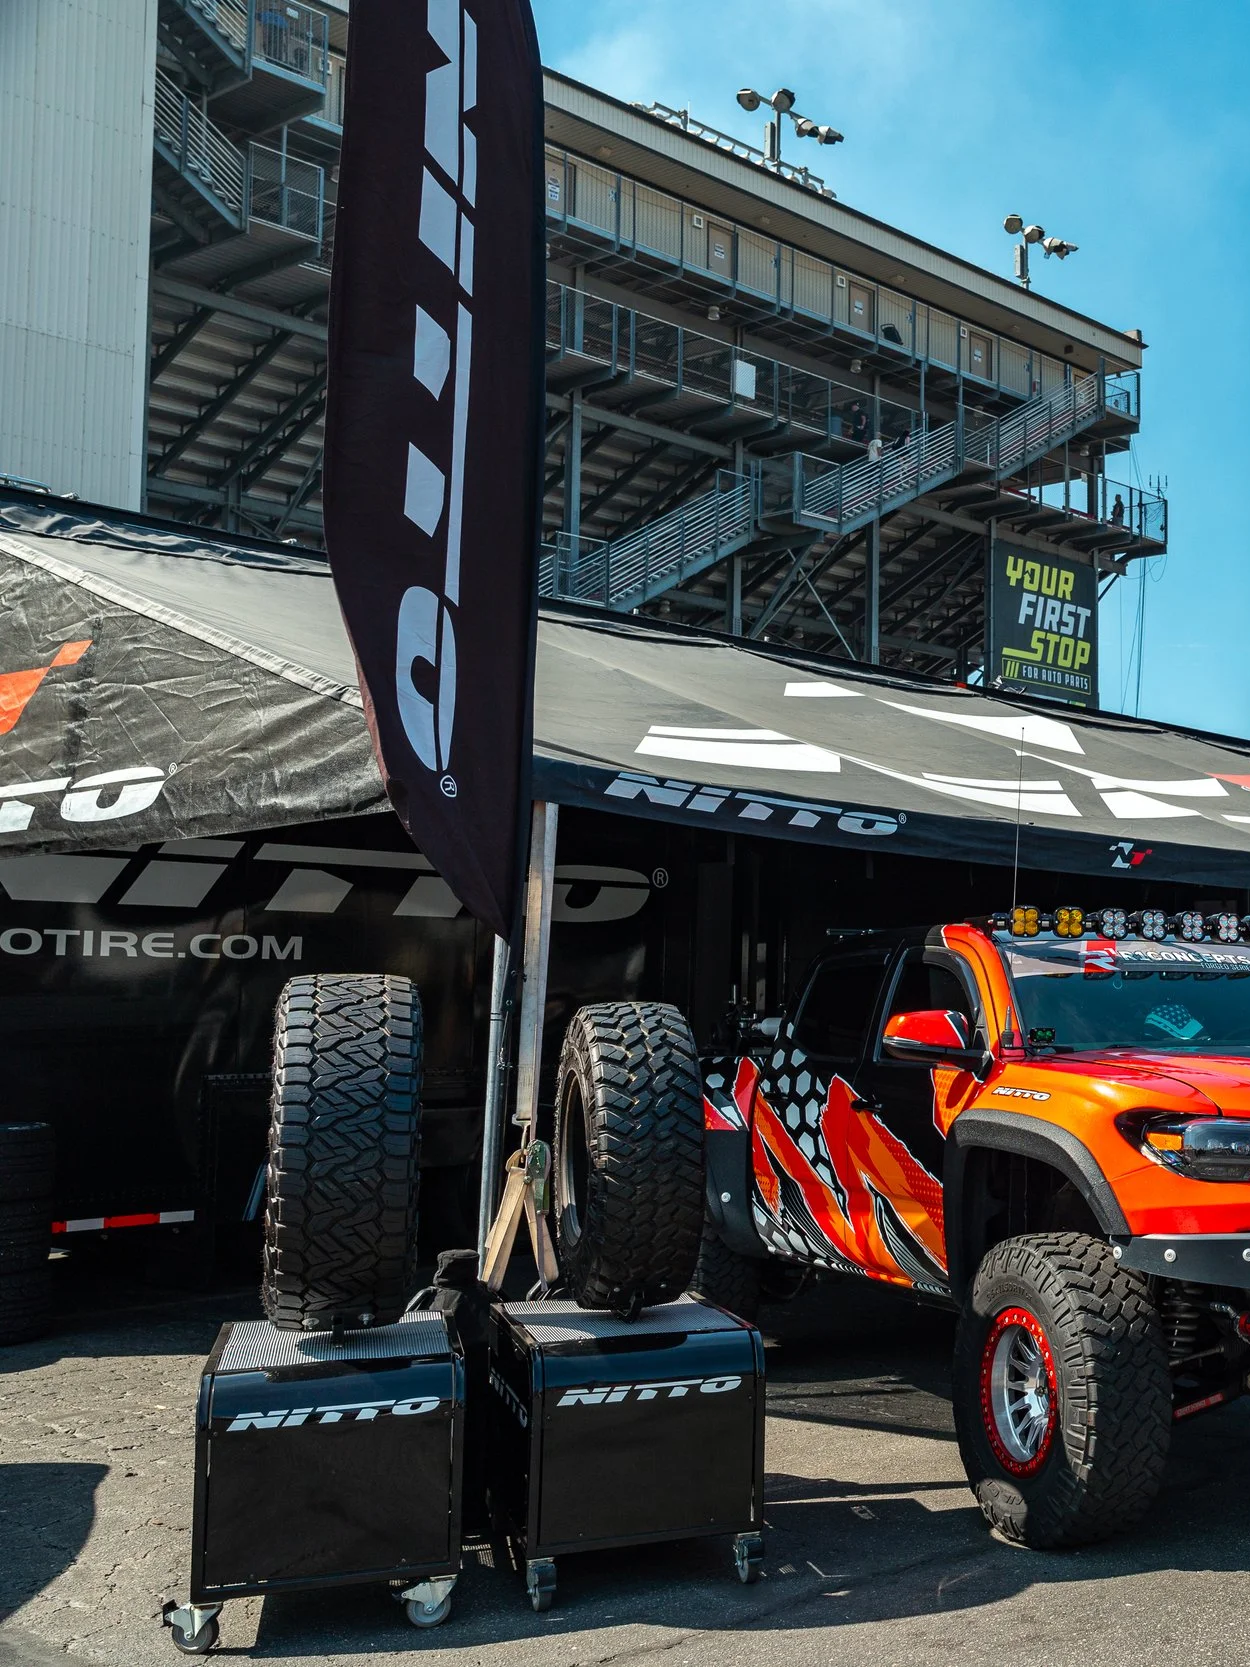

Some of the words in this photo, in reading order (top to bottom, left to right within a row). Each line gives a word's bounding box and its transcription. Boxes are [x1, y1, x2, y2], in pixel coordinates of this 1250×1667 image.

[1006, 555, 1075, 600] YOUR
[1018, 592, 1091, 638] FIRST
[1002, 629, 1091, 670] STOP
[1022, 665, 1038, 680] FOR
[1041, 670, 1062, 685] AUTO
[1065, 674, 1089, 690] PARTS
[603, 771, 899, 837] NITTO
[0, 928, 304, 961] OTIRE.COM
[992, 1086, 1052, 1101] NITTO
[556, 1375, 742, 1407] NITTO
[226, 1396, 440, 1432] NITTO
